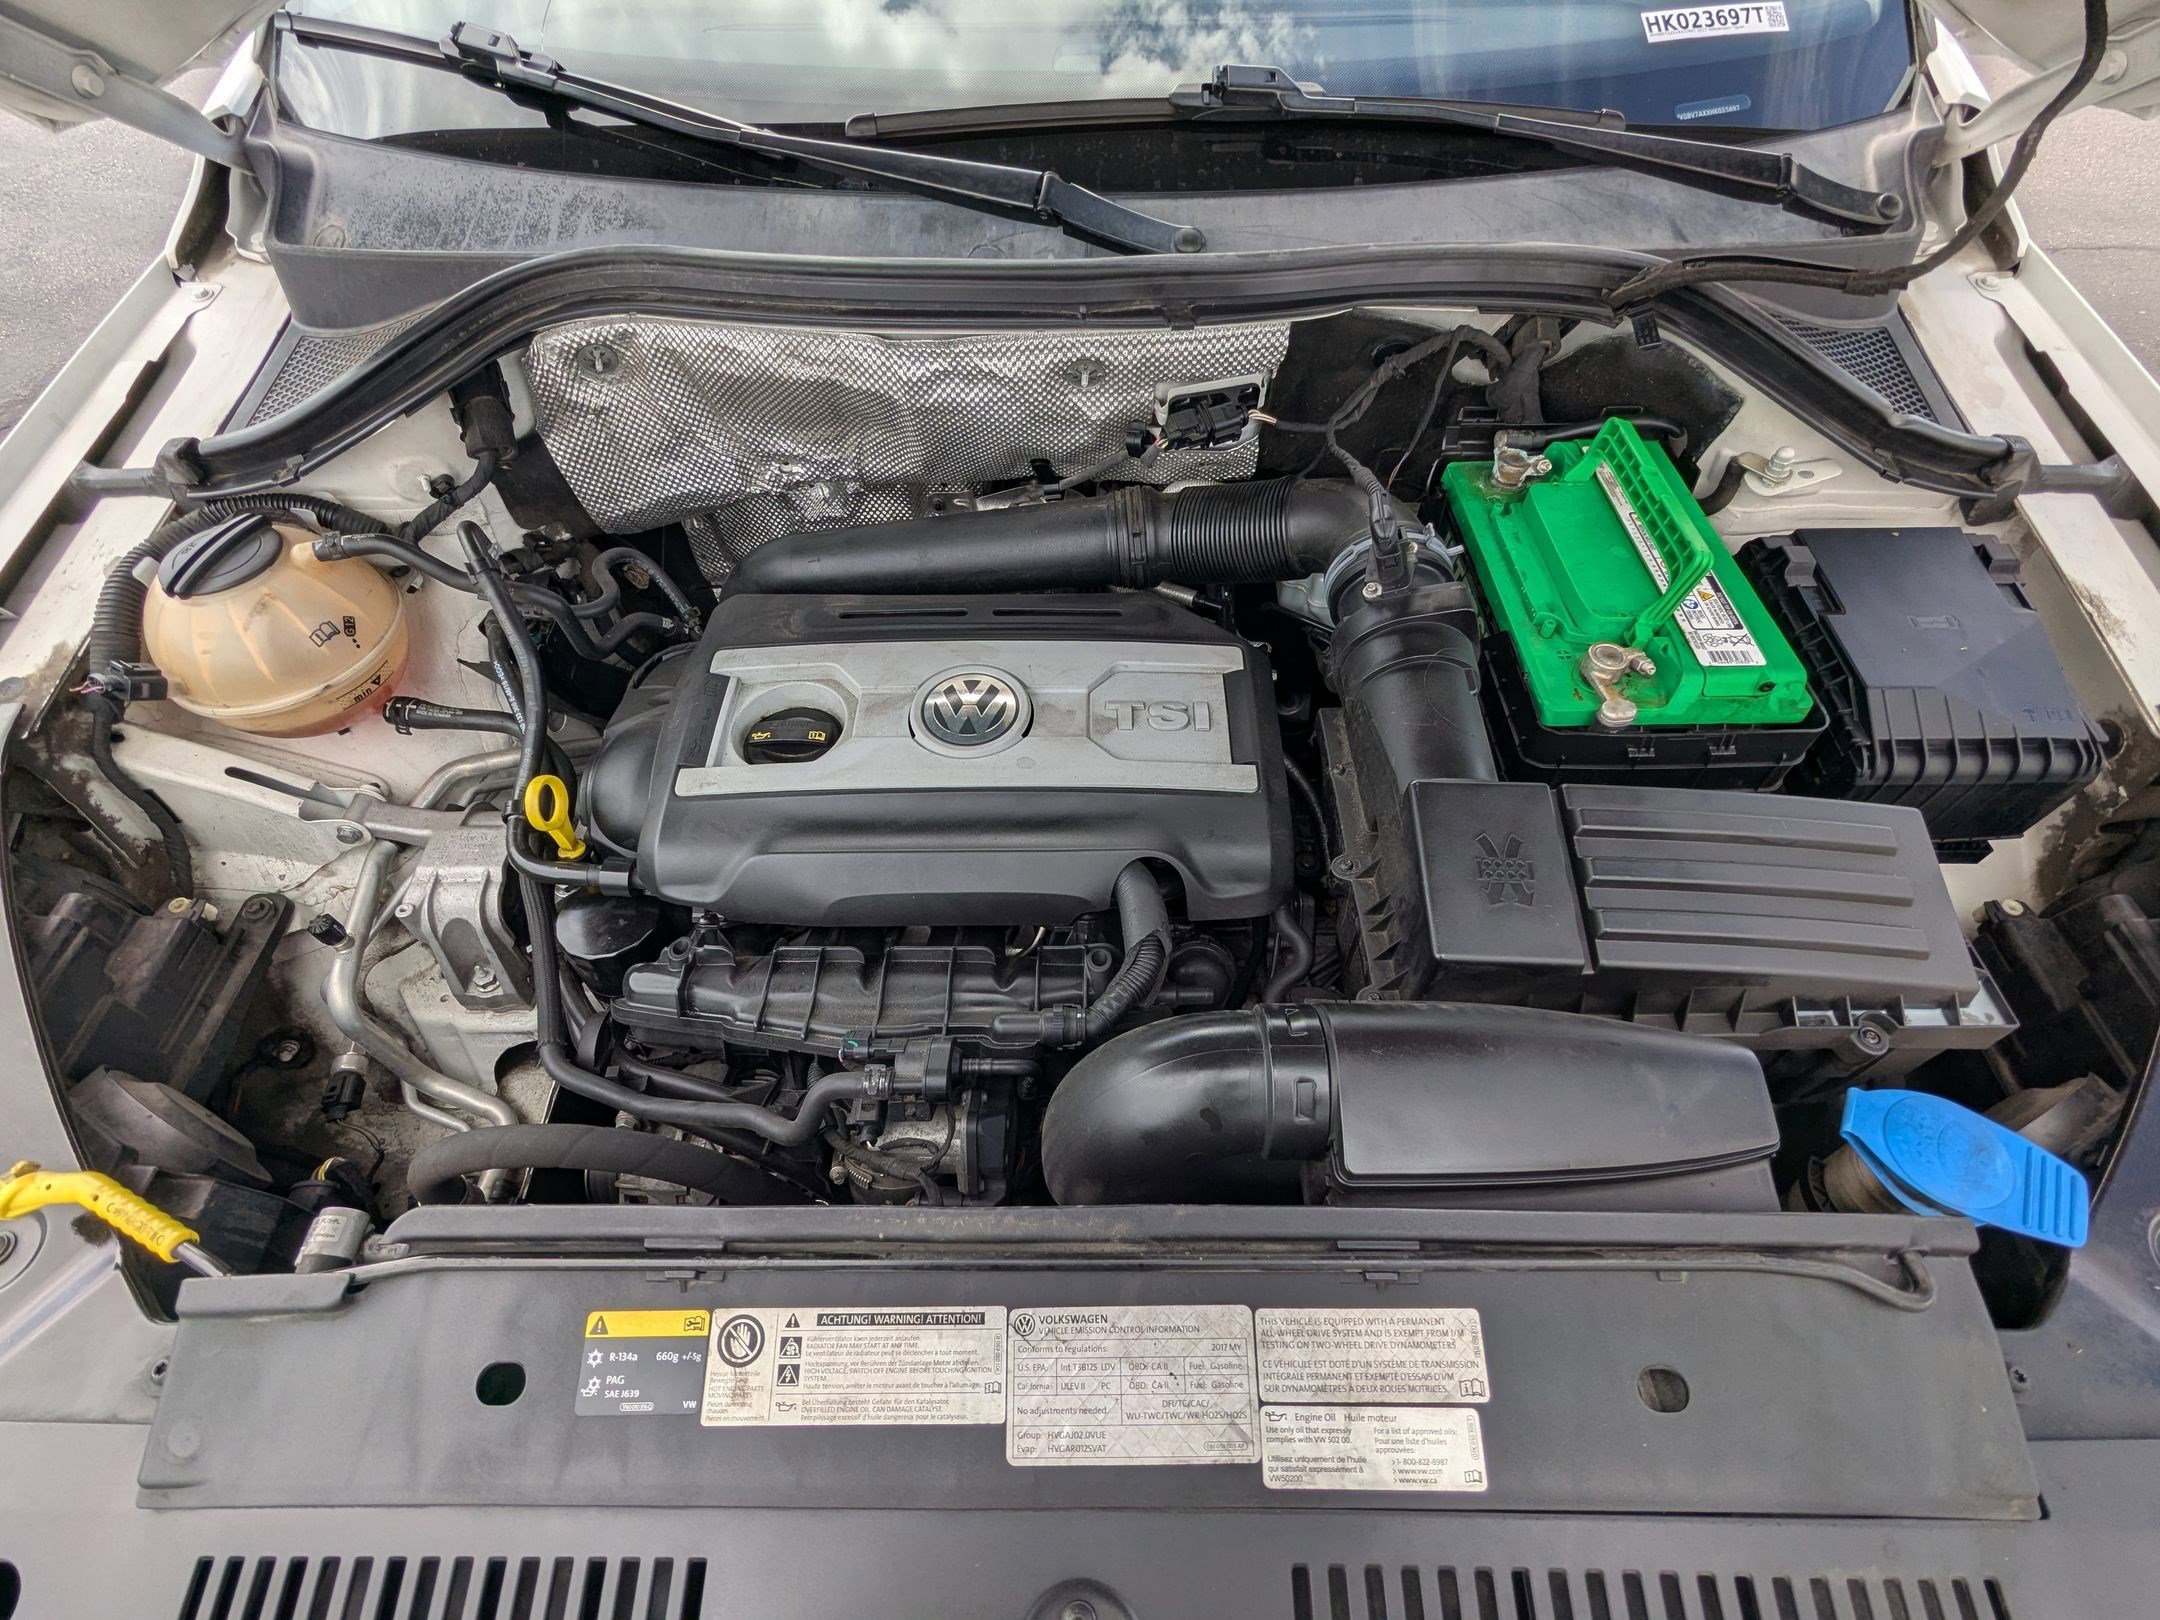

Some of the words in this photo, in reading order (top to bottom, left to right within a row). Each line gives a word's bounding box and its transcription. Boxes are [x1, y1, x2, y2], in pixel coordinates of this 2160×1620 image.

[1645, 6, 1763, 33] HK023697T
[344, 617, 355, 635] G12
[353, 687, 372, 703] min
[1103, 699, 1212, 732] TSI
[821, 1313, 871, 1325] ACHTUNG!
[874, 1313, 924, 1324] WARNING!
[926, 1312, 982, 1324] ATTENTION!
[1039, 1314, 1108, 1324] VOLKSWAGEN
[1260, 1318, 1278, 1326] THIS
[1279, 1318, 1313, 1326] VEHICLE
[1314, 1318, 1321, 1326] IS
[1324, 1318, 1364, 1327] EQUIPPED
[1366, 1318, 1387, 1326] WITH
[1389, 1318, 1395, 1326] A
[1397, 1318, 1446, 1326] PERMANENT
[1039, 1326, 1068, 1335] VEHICLE
[1070, 1326, 1107, 1334] EMISSION
[1109, 1326, 1144, 1334] CONTROL
[1146, 1325, 1200, 1333] INFORMATION
[1261, 1329, 1306, 1337] ALL-WHEEL
[1307, 1329, 1331, 1337] DRIVE
[1332, 1329, 1362, 1337] SYSTEM
[1364, 1329, 1383, 1337] AND
[1384, 1329, 1392, 1337] IS
[1394, 1329, 1424, 1338] EXEMPT
[1426, 1329, 1449, 1337] FROM
[1450, 1329, 1465, 1337] I/M
[1018, 1345, 1053, 1353] Conforms
[1065, 1345, 1109, 1355] regulations:
[1211, 1344, 1227, 1352] 2017
[1262, 1341, 1295, 1349] TESTING
[1296, 1341, 1309, 1349] ON
[1311, 1341, 1362, 1349] TWO-WHEEL
[1364, 1341, 1390, 1349] DRIVE
[1390, 1341, 1456, 1350] DYNAMOMETERS
[609, 1352, 638, 1362] R-134a
[656, 1351, 679, 1363] 660g
[681, 1352, 702, 1363] +/-5g
[1018, 1364, 1032, 1372] U.S.
[1101, 1363, 1116, 1371] LDV
[1151, 1362, 1163, 1370] CA
[1210, 1362, 1243, 1370] Gasoline
[1262, 1360, 1273, 1368] CE
[1314, 1360, 1327, 1368] EST
[1352, 1360, 1372, 1368] D'UN
[1409, 1360, 1420, 1368] DE
[1421, 1360, 1479, 1368] TRANSMISSION
[606, 1375, 625, 1385] PAG
[1306, 1372, 1353, 1380] PERMANENT
[1355, 1372, 1363, 1380] ET
[1061, 1382, 1079, 1390] ULEV
[1101, 1382, 1112, 1390] PC
[1152, 1381, 1162, 1389] CA
[1190, 1381, 1208, 1389] Fuel:
[1211, 1381, 1244, 1389] Gasoline
[1264, 1384, 1280, 1393] SUR
[1356, 1384, 1378, 1393] DEUX
[1380, 1384, 1407, 1393] ROUES
[604, 1390, 619, 1398] SAE
[620, 1390, 640, 1398] J639
[682, 1400, 697, 1409] VW
[1017, 1407, 1028, 1415] No
[1030, 1407, 1077, 1417] adjustments
[1079, 1406, 1109, 1414] needed.
[1295, 1413, 1323, 1423] Engine
[1324, 1412, 1336, 1421] Oil
[1344, 1413, 1366, 1422] Huile
[1367, 1414, 1397, 1422] moteur
[1280, 1426, 1294, 1435] only
[1295, 1426, 1304, 1434] oil
[1321, 1427, 1352, 1435] expressly
[1374, 1427, 1384, 1435] For
[1412, 1428, 1442, 1436] approved
[1017, 1432, 1043, 1440] Group:
[1266, 1436, 1296, 1445] complies
[1328, 1436, 1340, 1444] 502
[1017, 1445, 1037, 1454] Evap:
[1268, 1455, 1293, 1463] Utilisez
[1294, 1456, 1335, 1465] uniquement
[1268, 1465, 1279, 1474] qui
[1281, 1465, 1307, 1473] satisfait
